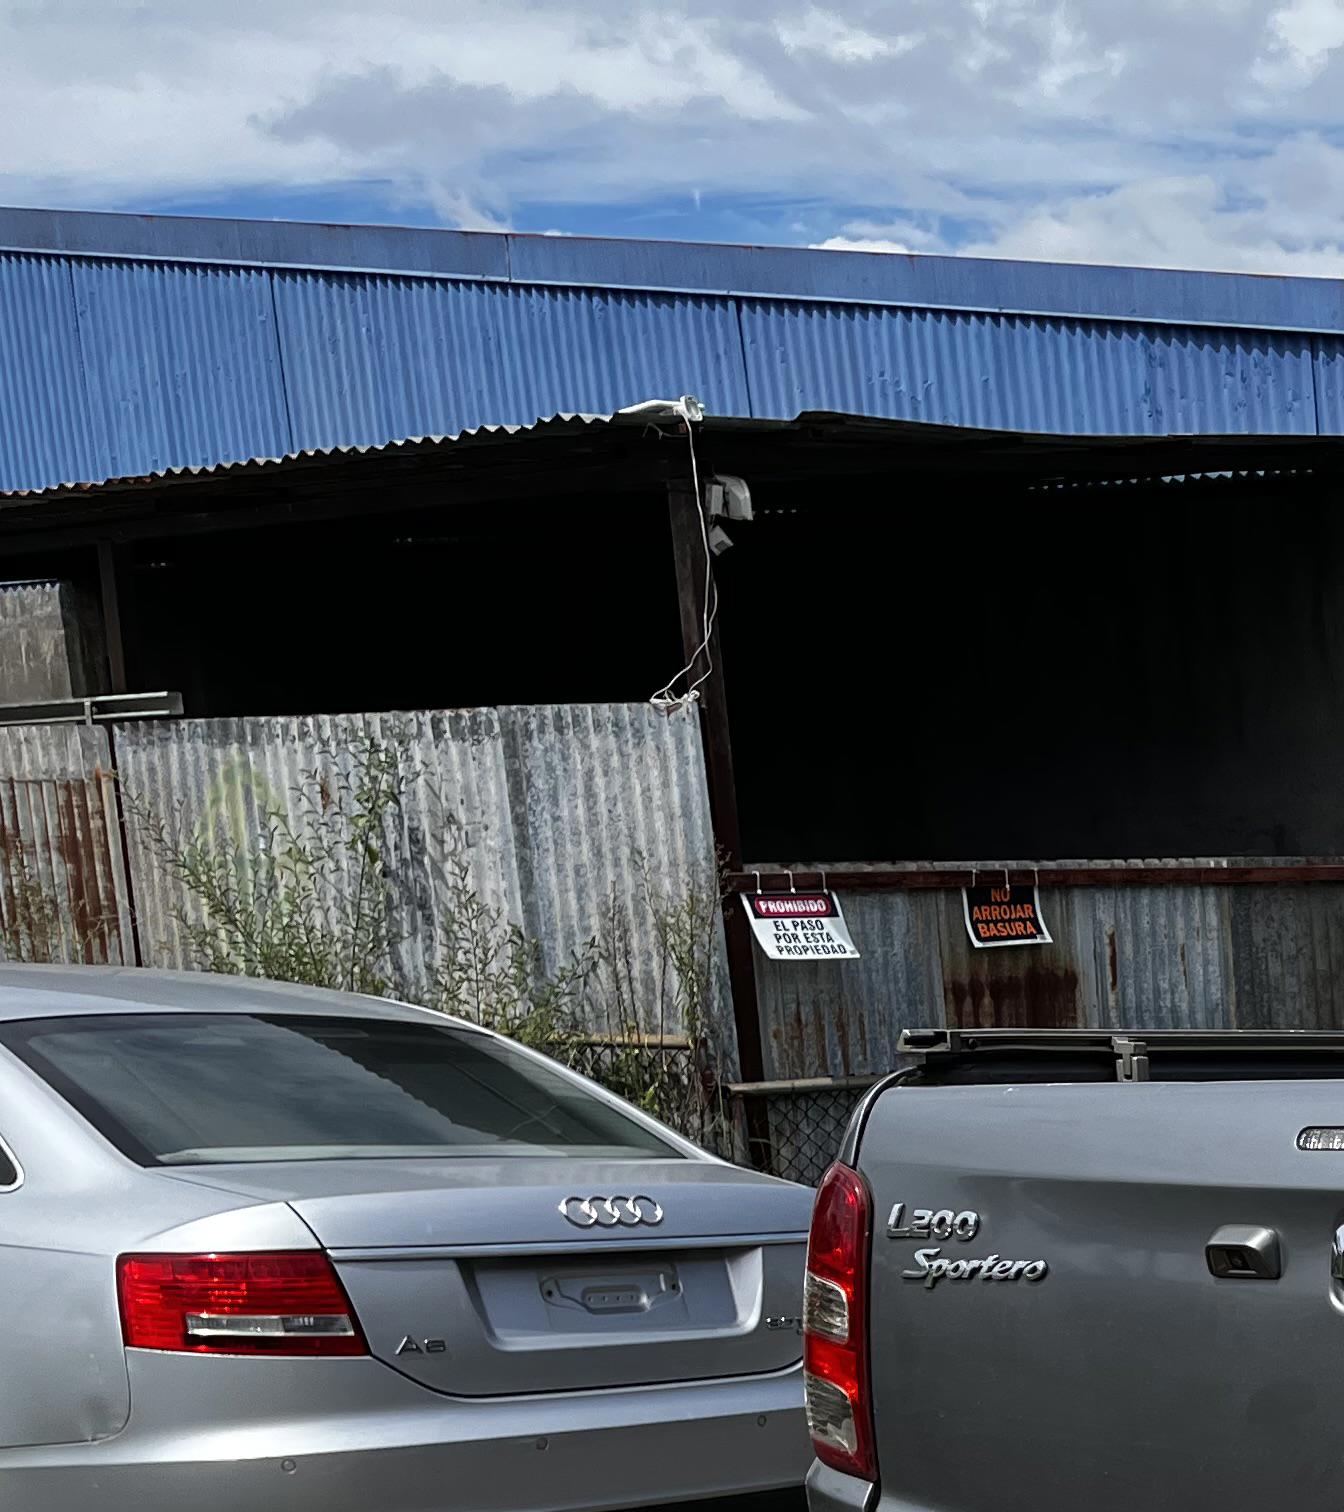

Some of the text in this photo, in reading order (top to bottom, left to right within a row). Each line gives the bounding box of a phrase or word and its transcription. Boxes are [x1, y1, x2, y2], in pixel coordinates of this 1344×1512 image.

[991, 887, 1010, 902] NO
[759, 899, 827, 913] PROHIBIDO
[973, 904, 1034, 921] ARROJAR
[773, 919, 825, 932] EL PASO
[977, 921, 1037, 938] BASURA
[774, 932, 836, 945] POR ESTA
[776, 944, 848, 956] PROPIEDAD
[886, 1202, 980, 1241] L200
[902, 1247, 1049, 1289] Sportero
[394, 1335, 447, 1356] A6
